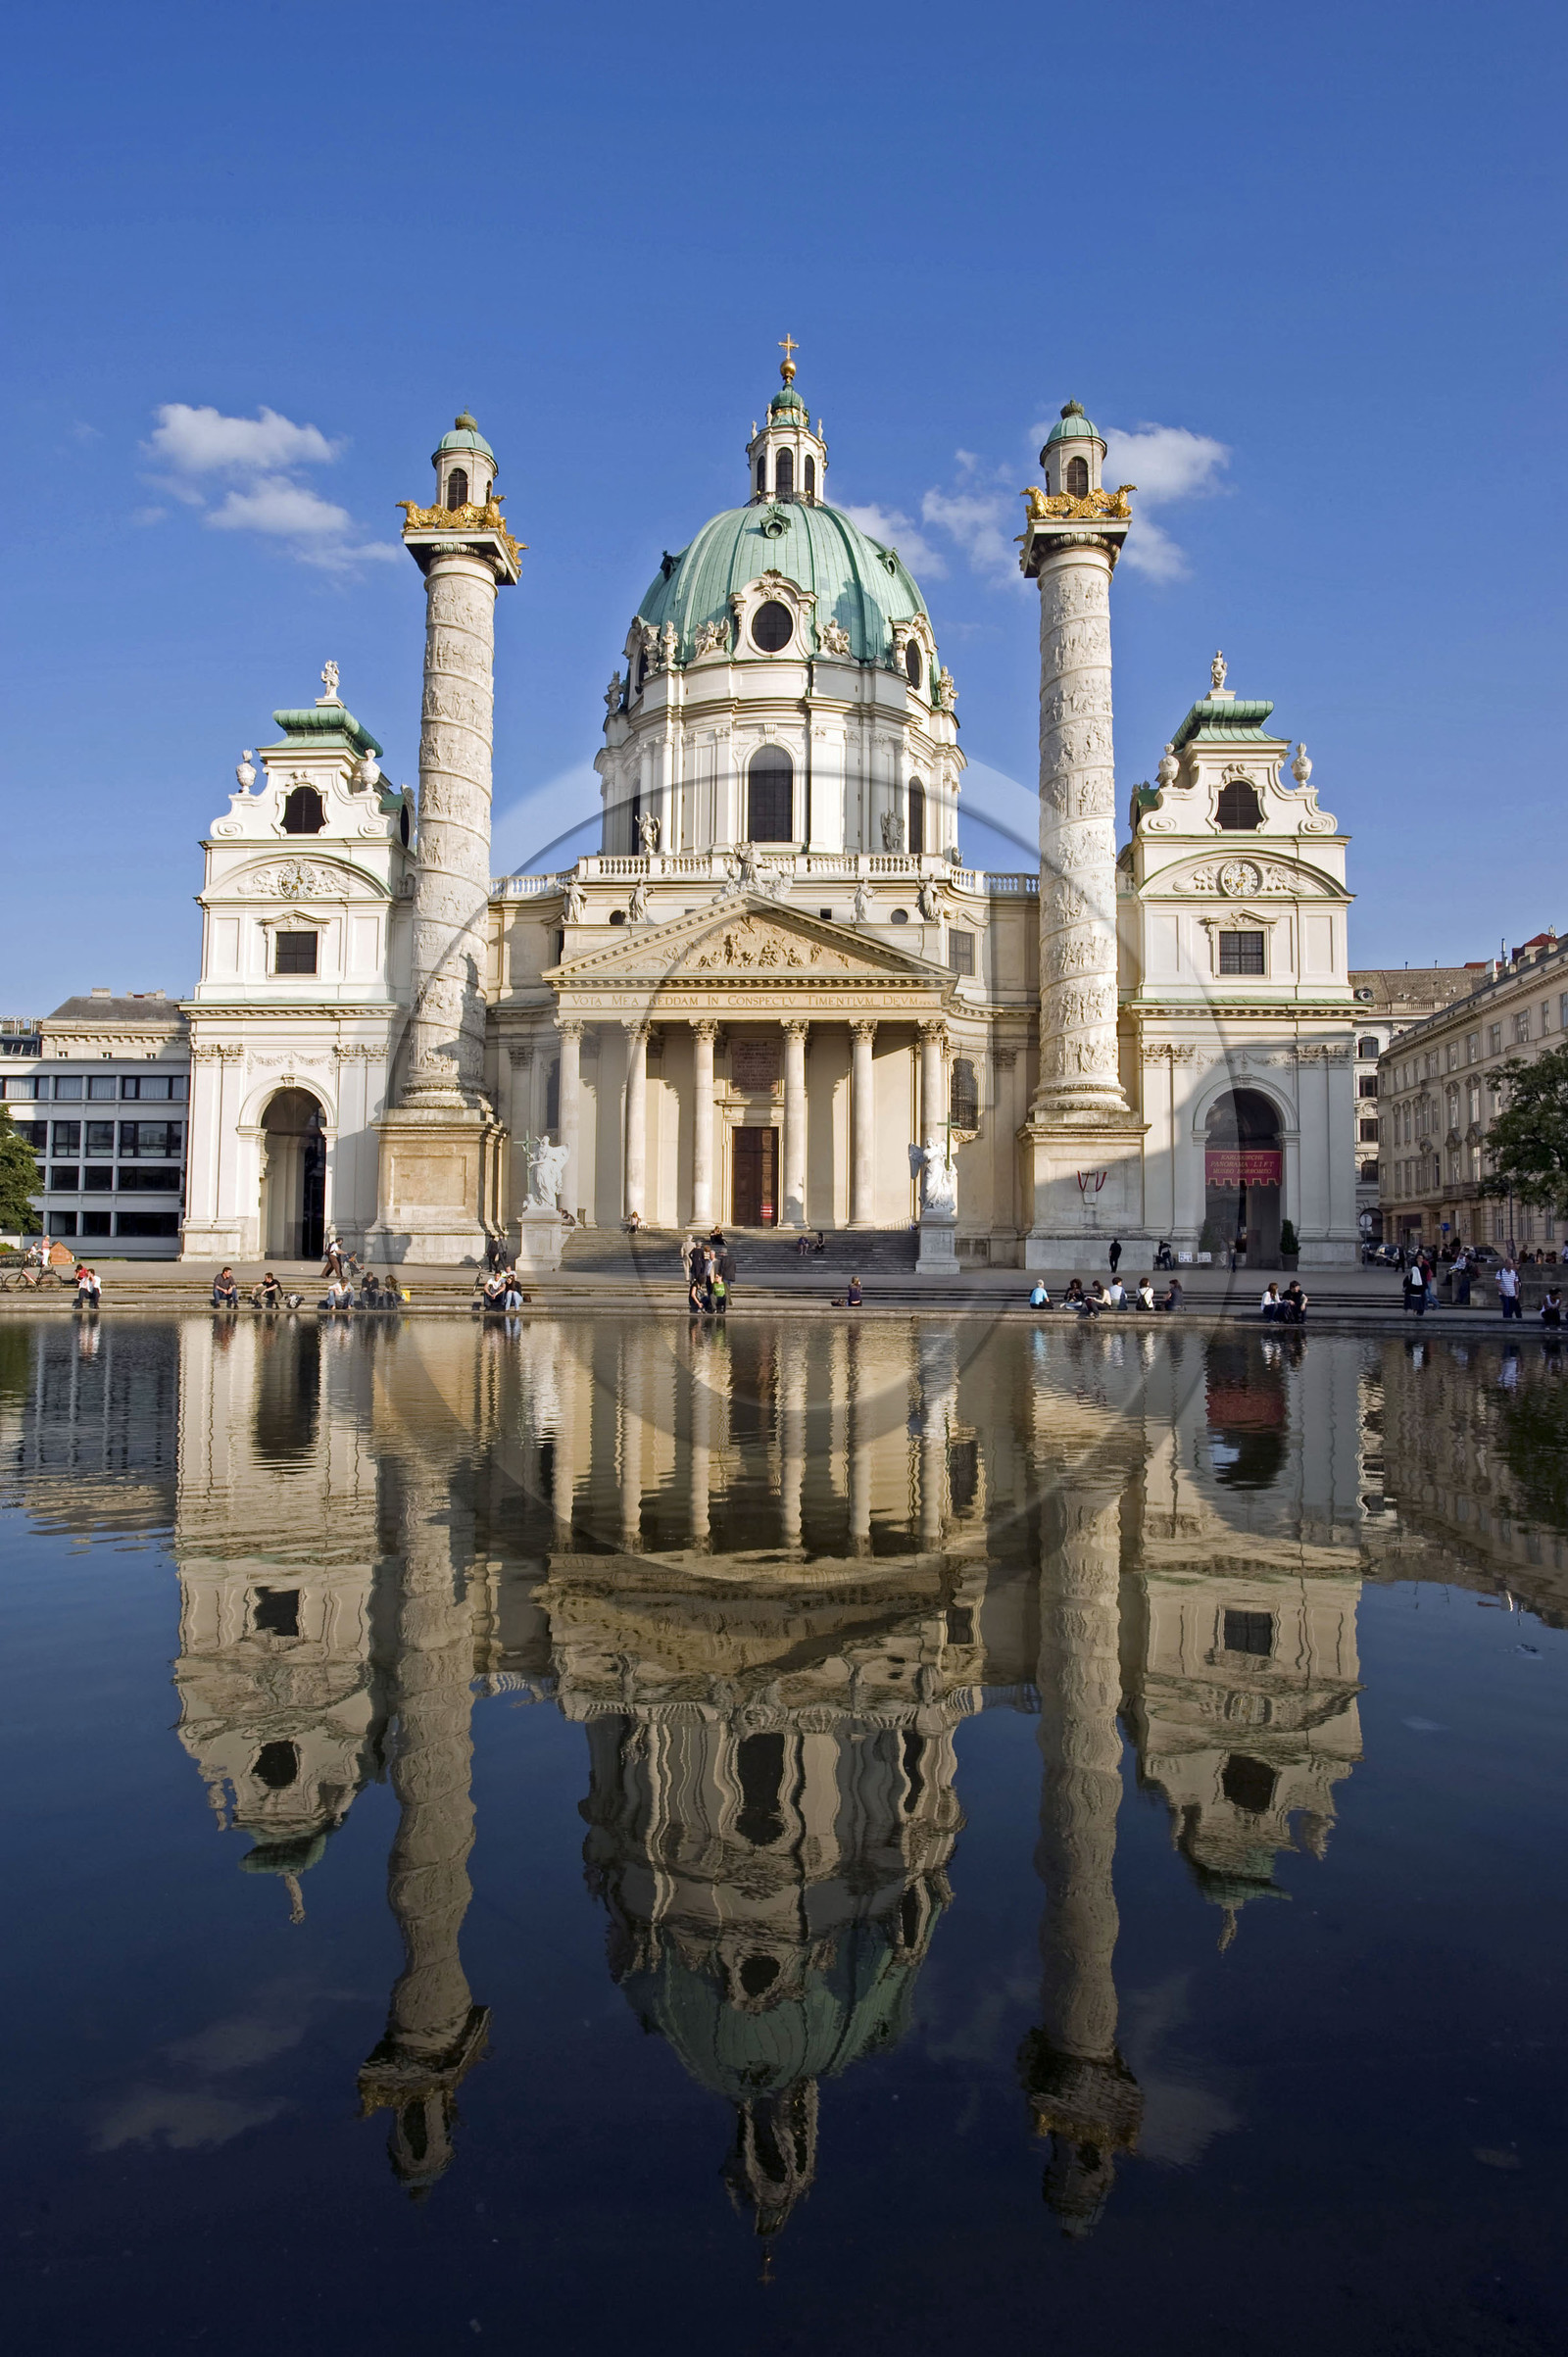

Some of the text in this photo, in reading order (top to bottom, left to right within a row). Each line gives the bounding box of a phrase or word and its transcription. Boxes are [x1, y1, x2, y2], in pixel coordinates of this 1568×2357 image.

[571, 995, 603, 1007] VOTA
[612, 995, 639, 1007] MEA
[648, 995, 699, 1006] REDDAM
[707, 995, 719, 1006] IN
[727, 995, 797, 1007] CONSPECTV
[883, 995, 918, 1007] DEVM
